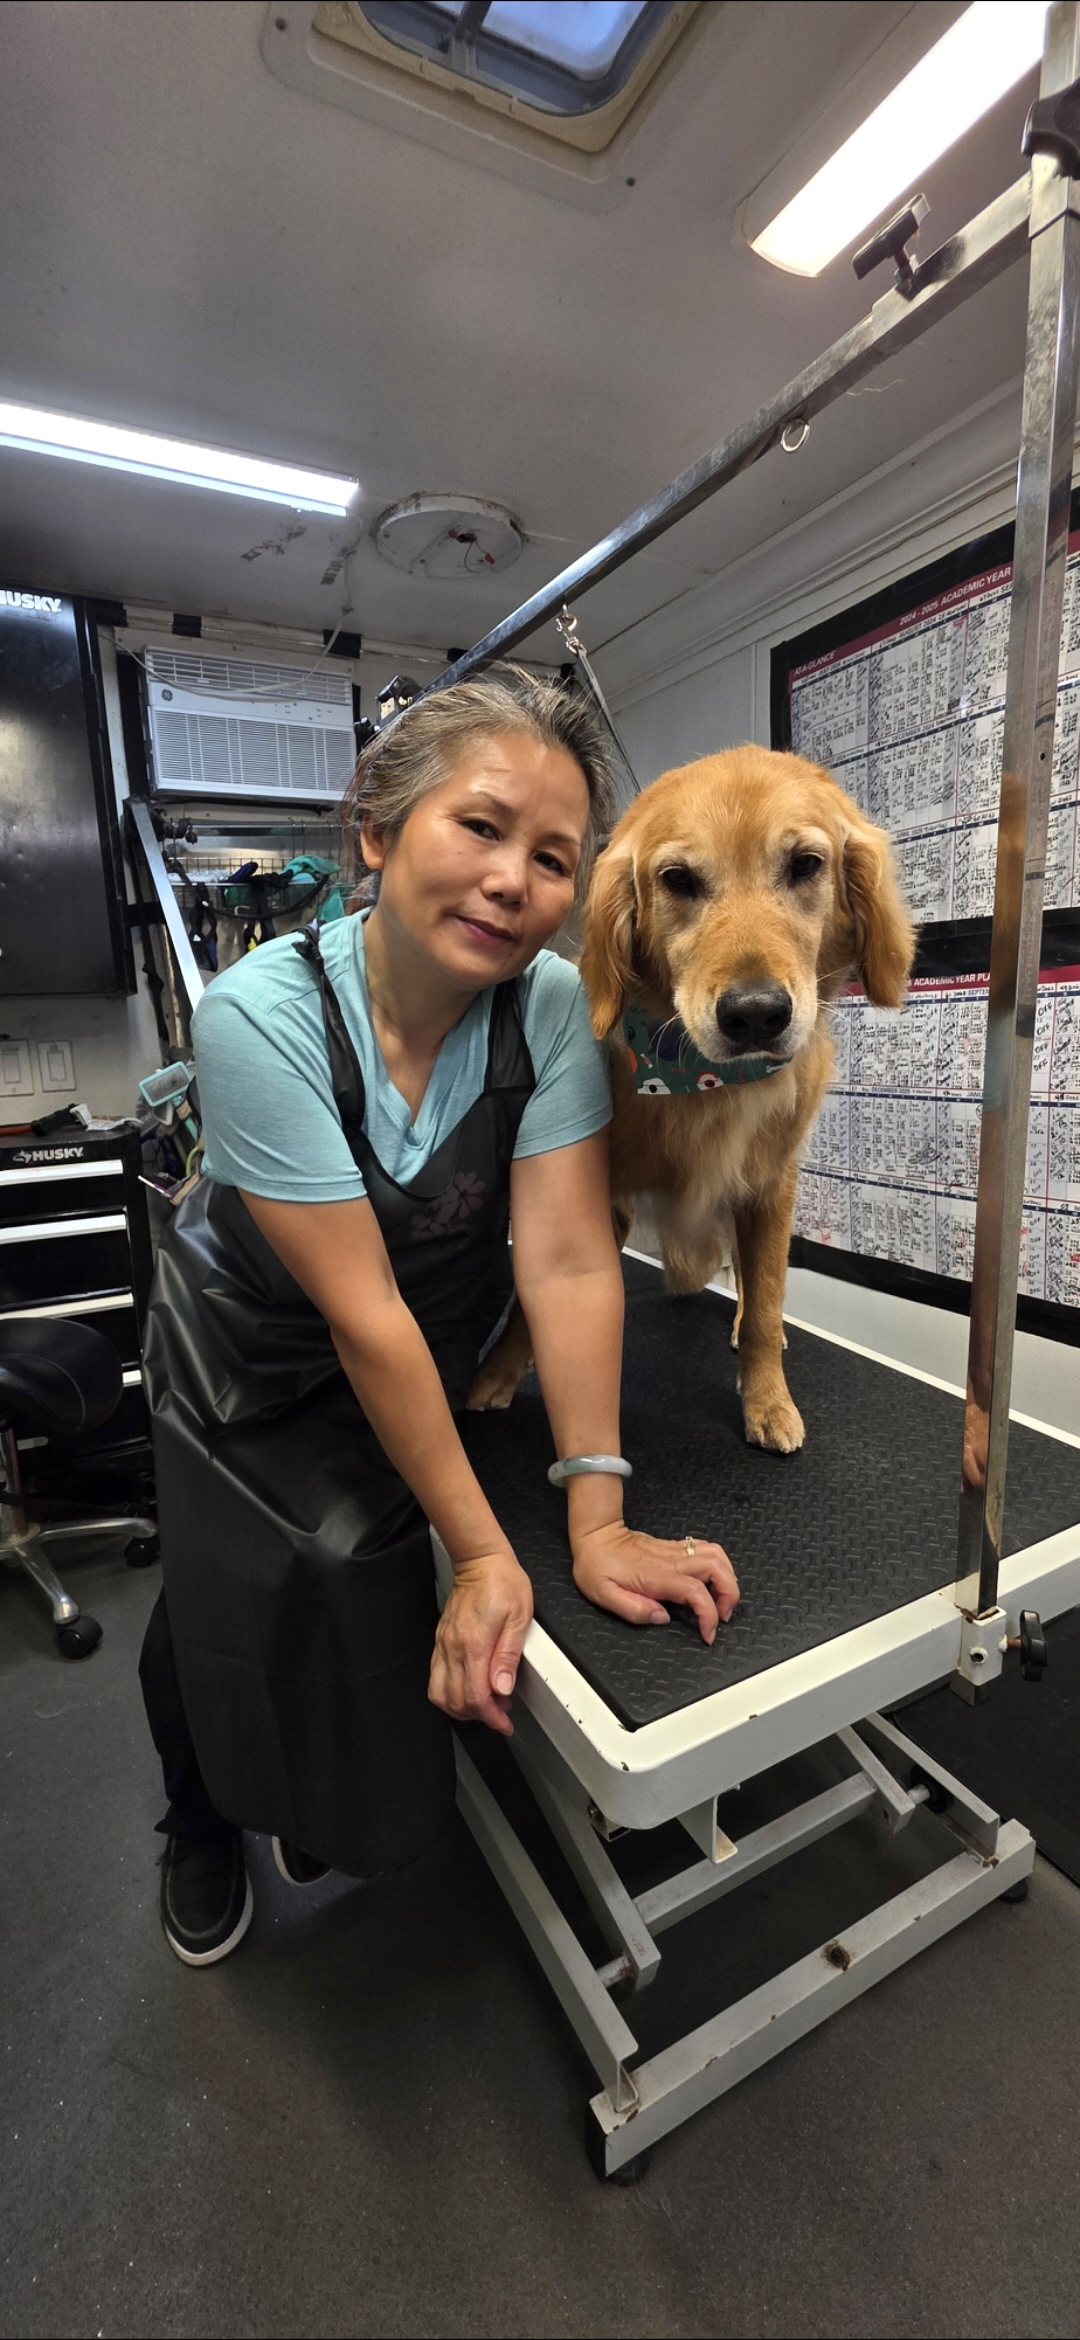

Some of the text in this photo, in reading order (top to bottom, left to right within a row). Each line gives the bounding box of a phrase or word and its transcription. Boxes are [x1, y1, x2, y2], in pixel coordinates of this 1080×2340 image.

[899, 611, 916, 626] 2024
[920, 600, 939, 616] 2025
[940, 579, 985, 606] ACADEMIC
[986, 566, 1011, 585] YEAR
[914, 975, 955, 987] ACADEMIC
[955, 974, 976, 983] YEAR
[32, 1146, 83, 1161] HUSKY
